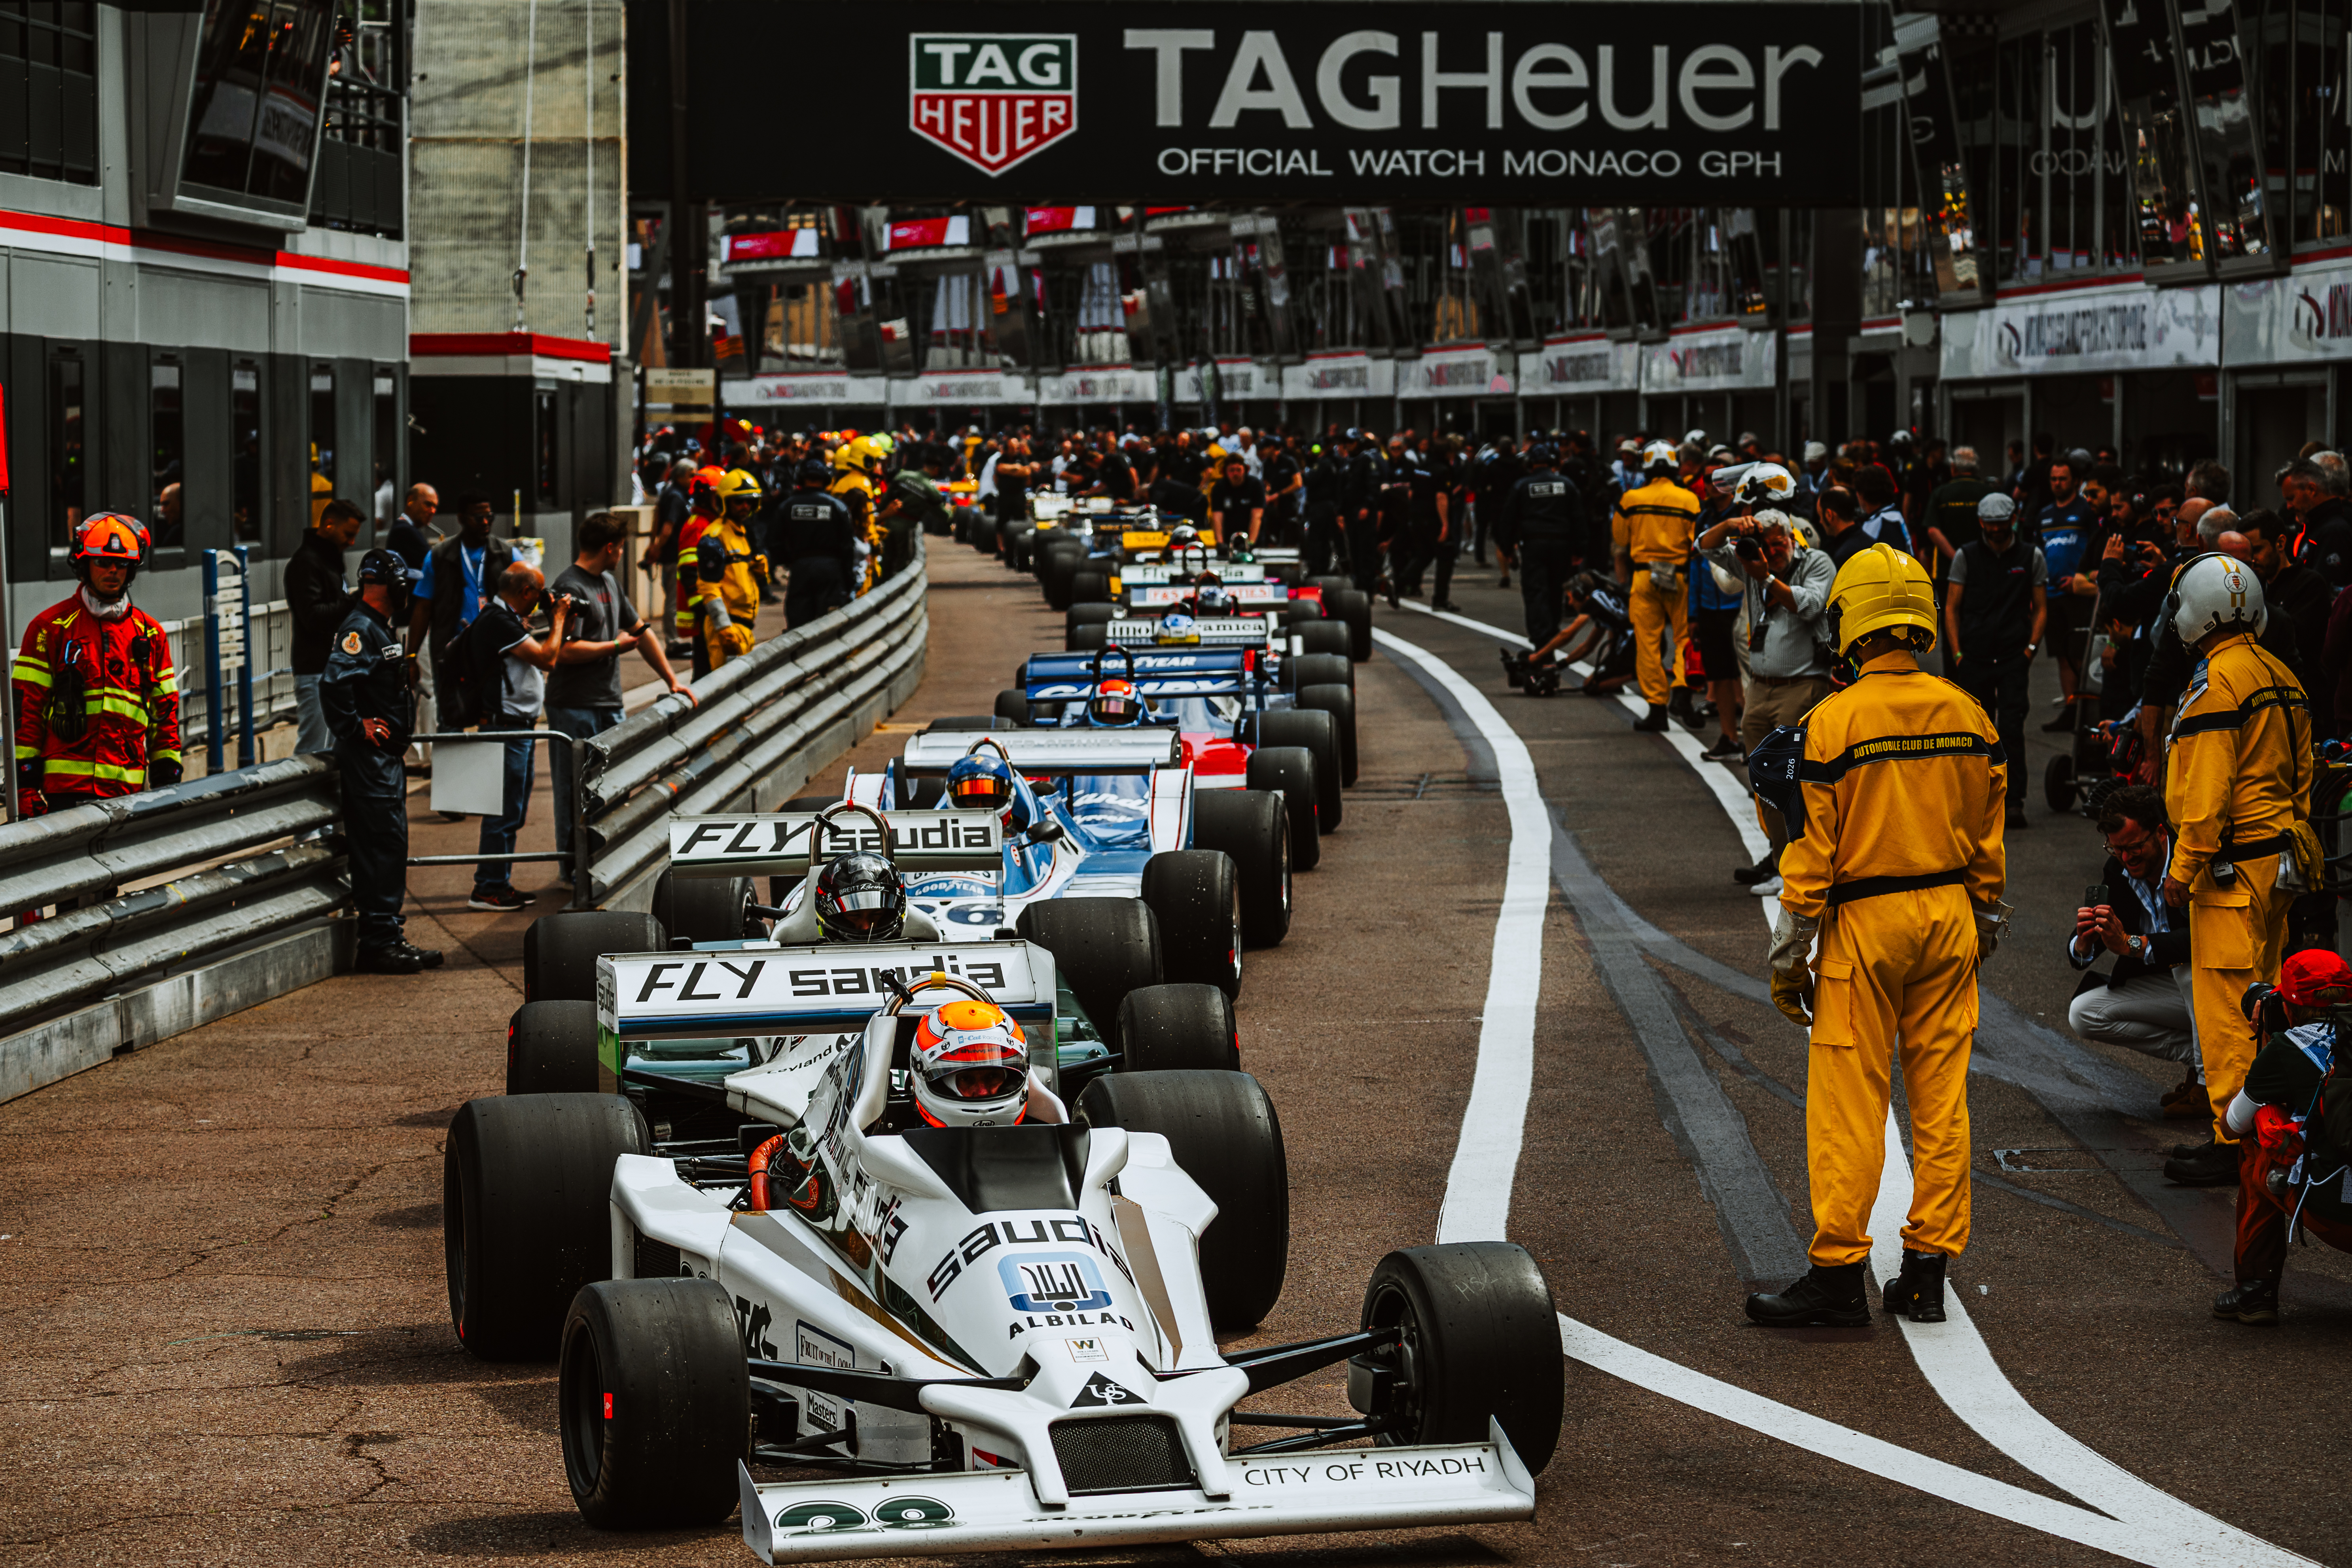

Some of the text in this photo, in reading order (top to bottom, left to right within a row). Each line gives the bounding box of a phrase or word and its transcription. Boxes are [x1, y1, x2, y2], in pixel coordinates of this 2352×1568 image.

[924, 44, 1061, 85] TAG
[920, 99, 1067, 164] HEUER
[1157, 148, 1782, 178] OFFICIAL WATCH MONACO GPH
[1853, 736, 1972, 759] AUTOMOBILE CLUB DE MONACO
[1786, 758, 1795, 780] 2026
[677, 818, 991, 853] FLY saudia
[839, 883, 886, 895] BREITT Racing
[915, 879, 985, 896] GOODYEAR
[636, 955, 1006, 1002] FLY saudia
[598, 981, 614, 1016] saudia
[767, 1045, 832, 1075] Leyland
[926, 1215, 1136, 1304] saudia
[1009, 1312, 1135, 1341] ALBILAD
[800, 1334, 819, 1361] FRUIT
[819, 1349, 824, 1362] OF
[824, 1352, 833, 1366] THE
[807, 1392, 836, 1426] Masters
[808, 1414, 824, 1428] HISTORIC
[1244, 1456, 1487, 1486] CITY OF RIYADH
[773, 1494, 968, 1539] 28
